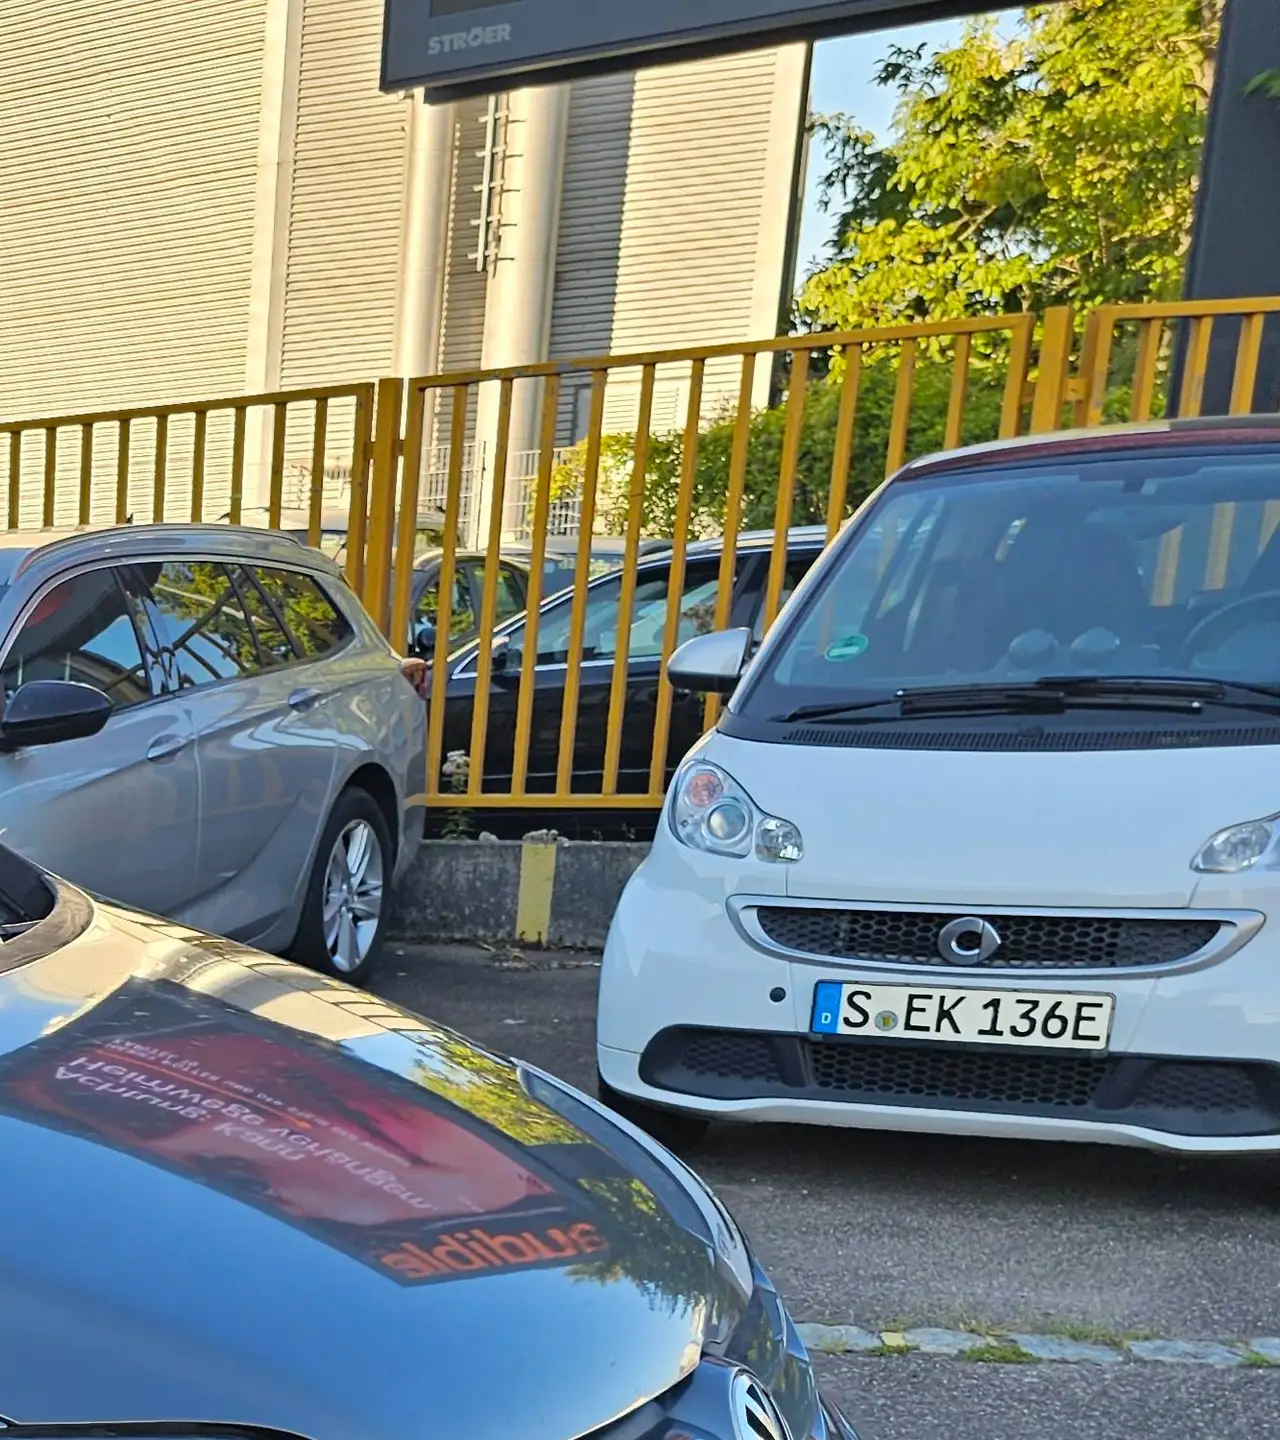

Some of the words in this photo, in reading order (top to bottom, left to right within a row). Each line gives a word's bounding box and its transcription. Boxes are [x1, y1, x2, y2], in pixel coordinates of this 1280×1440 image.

[821, 1013, 831, 1024] D
[842, 990, 872, 1028] S
[904, 993, 966, 1034] EK
[978, 998, 1103, 1041] 136E
